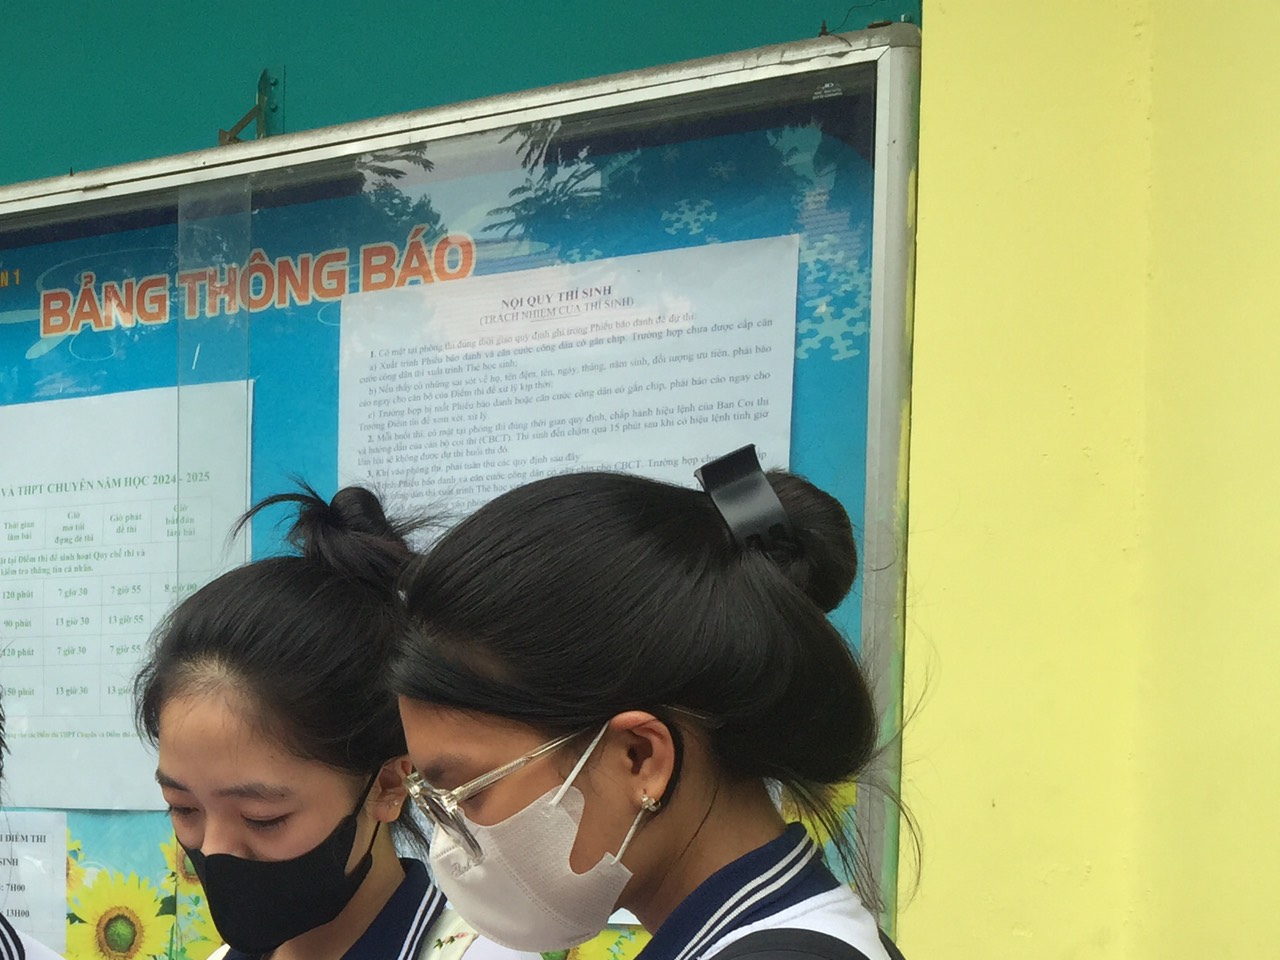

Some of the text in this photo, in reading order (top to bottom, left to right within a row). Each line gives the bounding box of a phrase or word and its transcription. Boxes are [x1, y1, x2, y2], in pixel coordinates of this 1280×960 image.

[13, 269, 20, 286] 1
[40, 224, 476, 338] BẢNG THÔNG BÁO
[501, 295, 522, 310] NỘI
[526, 293, 552, 307] QUY
[581, 285, 611, 298] SINH
[604, 296, 633, 312] SINH)
[0, 485, 14, 497] VÀ
[17, 485, 44, 496] THPT
[46, 478, 93, 493] CHUYÊN
[96, 476, 122, 490] NĂM
[124, 476, 149, 490] HỌC
[152, 474, 176, 485] 2024
[186, 471, 210, 483] 2025
[111, 586, 115, 594] 7
[129, 585, 141, 593] 55
[164, 583, 168, 591] 8
[2, 591, 15, 599] 120
[58, 589, 62, 597] 7
[76, 587, 88, 596] 30
[54, 618, 63, 626] 13
[78, 617, 89, 625] 30
[108, 615, 117, 624] 13
[132, 614, 143, 623] 55
[3, 620, 14, 628] 90
[75, 646, 86, 654] 30
[109, 645, 113, 653] 7
[130, 644, 140, 652] 55
[55, 686, 63, 695] 13
[78, 686, 88, 694] 30
[107, 685, 115, 693] 13
[30, 834, 47, 843] THI
[6, 883, 26, 892] 7H00
[6, 909, 30, 918] 13H00
